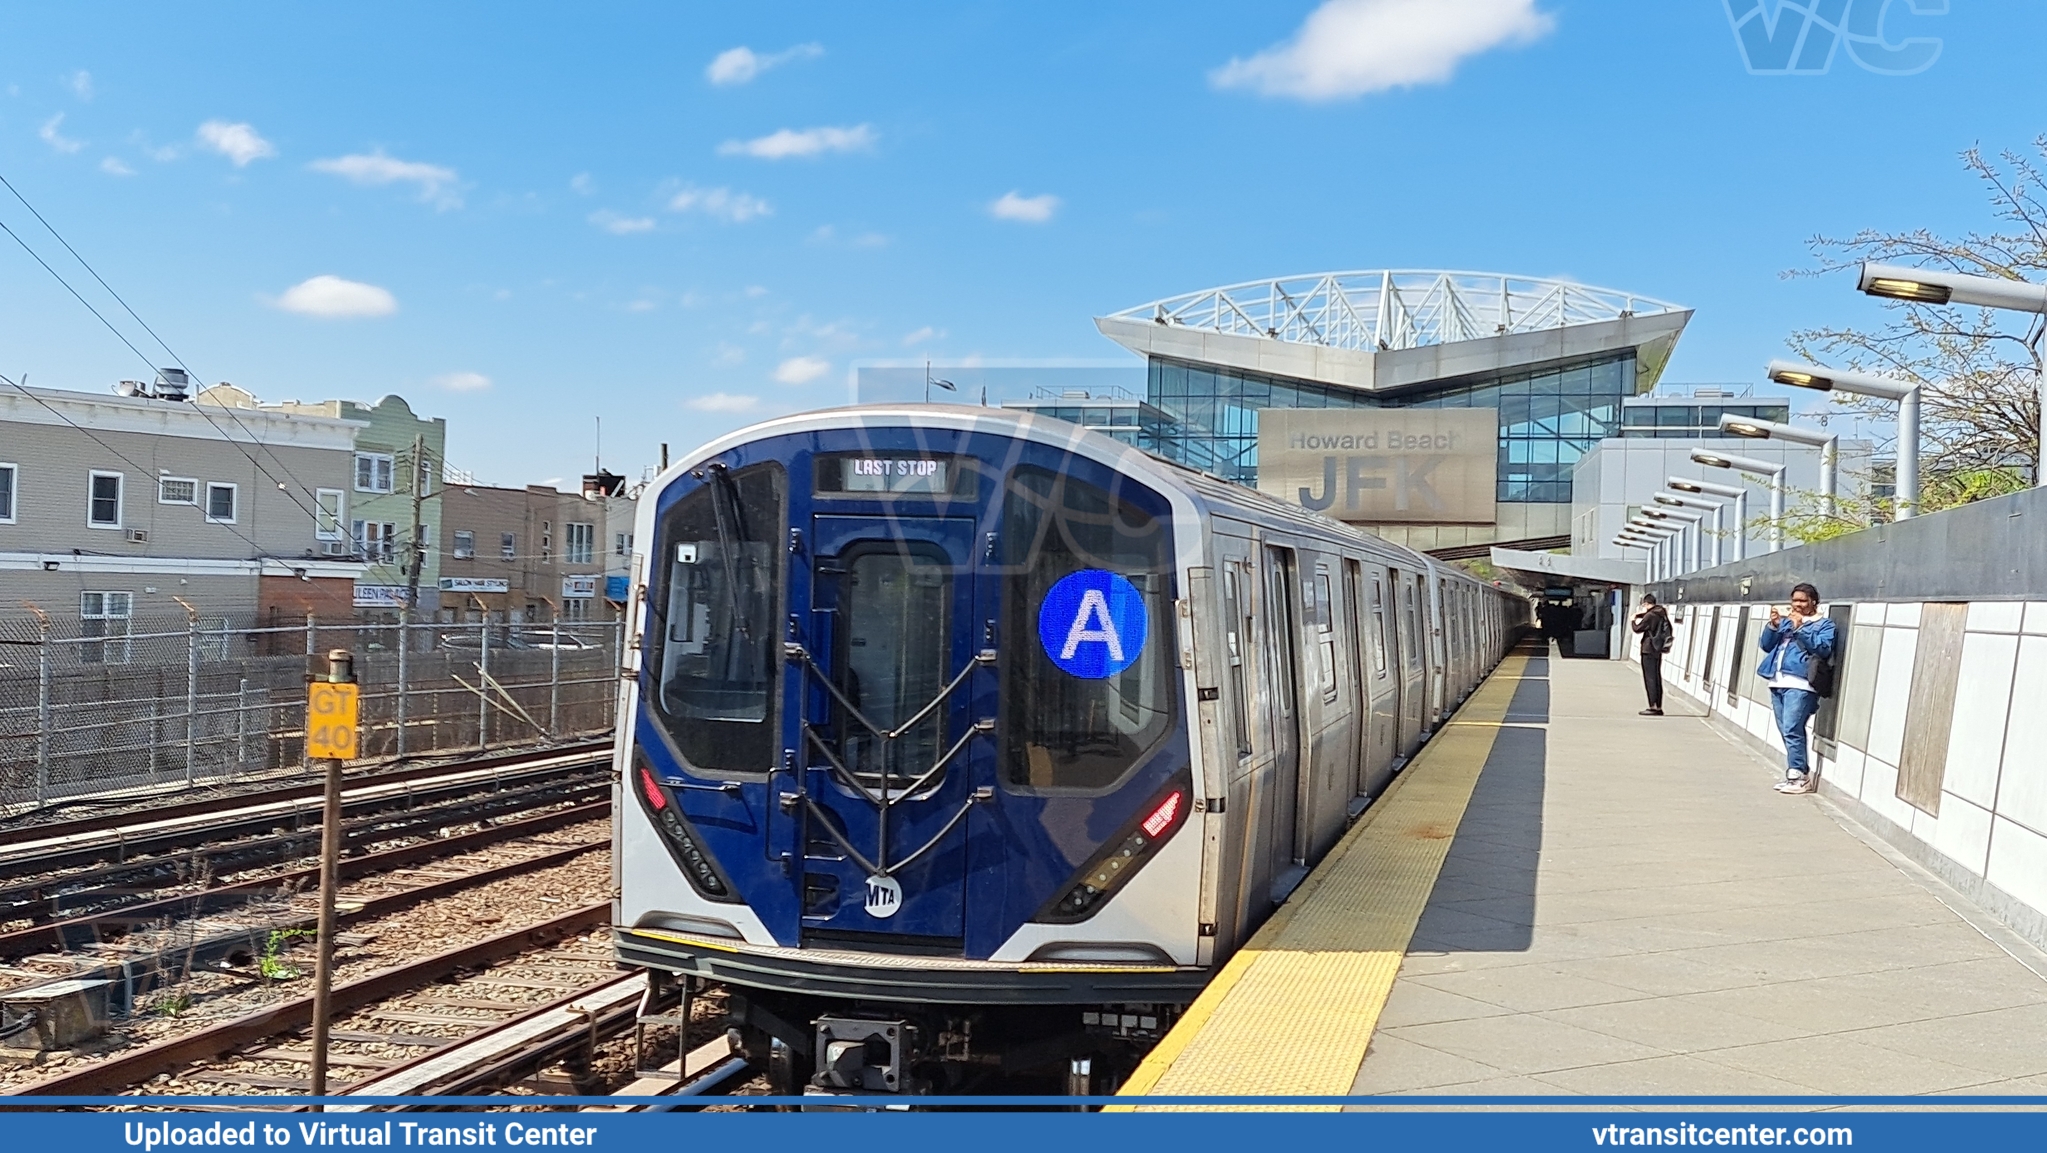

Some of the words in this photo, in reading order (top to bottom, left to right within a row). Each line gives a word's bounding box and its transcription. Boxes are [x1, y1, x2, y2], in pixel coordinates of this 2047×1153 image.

[1290, 431, 1379, 450] Howard
[1387, 430, 1461, 450] Beach
[855, 459, 892, 476] LAST
[898, 460, 937, 476] STOP
[1298, 455, 1446, 512] JFK
[1060, 589, 1124, 661] A
[314, 690, 352, 714] GT
[313, 725, 351, 750] 40
[864, 883, 895, 908] MTA
